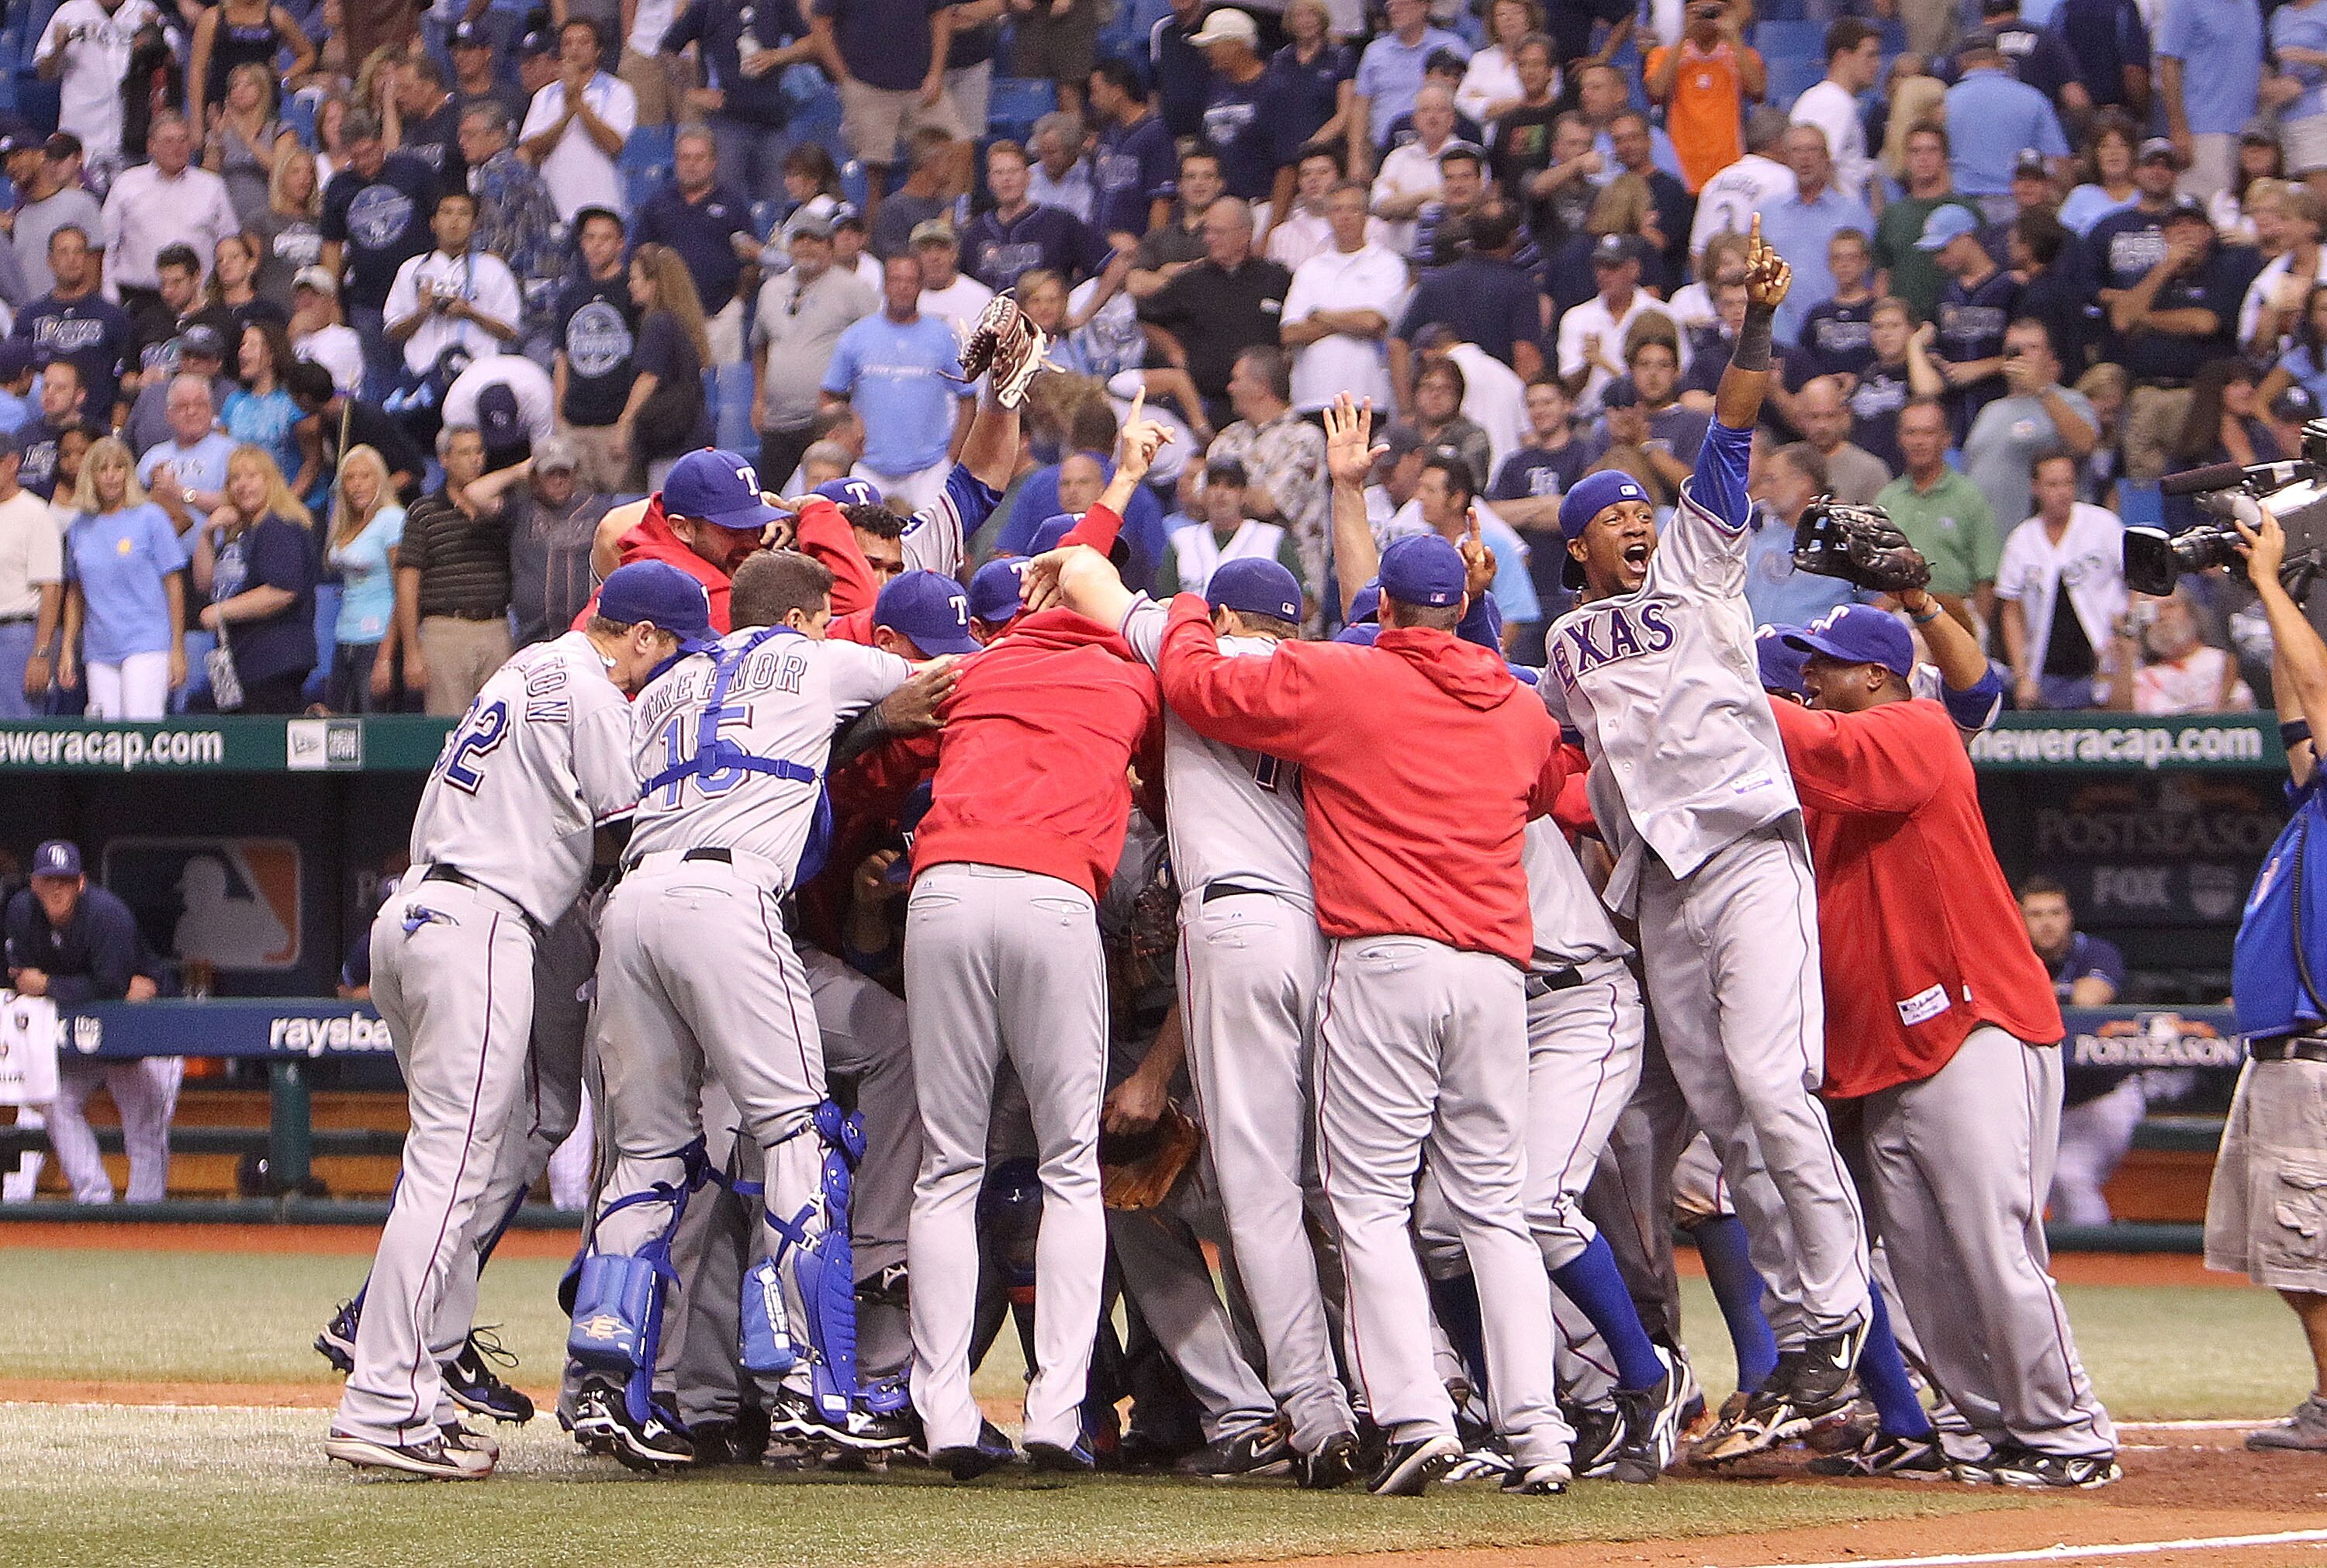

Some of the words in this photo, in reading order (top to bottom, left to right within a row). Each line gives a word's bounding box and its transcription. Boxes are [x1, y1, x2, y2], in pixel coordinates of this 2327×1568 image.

[736, 466, 761, 496] T
[844, 482, 870, 506] T
[949, 595, 968, 625] T
[1551, 602, 1677, 692] EXAS
[0, 730, 225, 772] weracap.com
[659, 702, 753, 811] 15
[1969, 727, 2263, 770] neweracap.com
[269, 1010, 393, 1058] raysba
[2074, 1034, 2243, 1066] POSTSEASON
